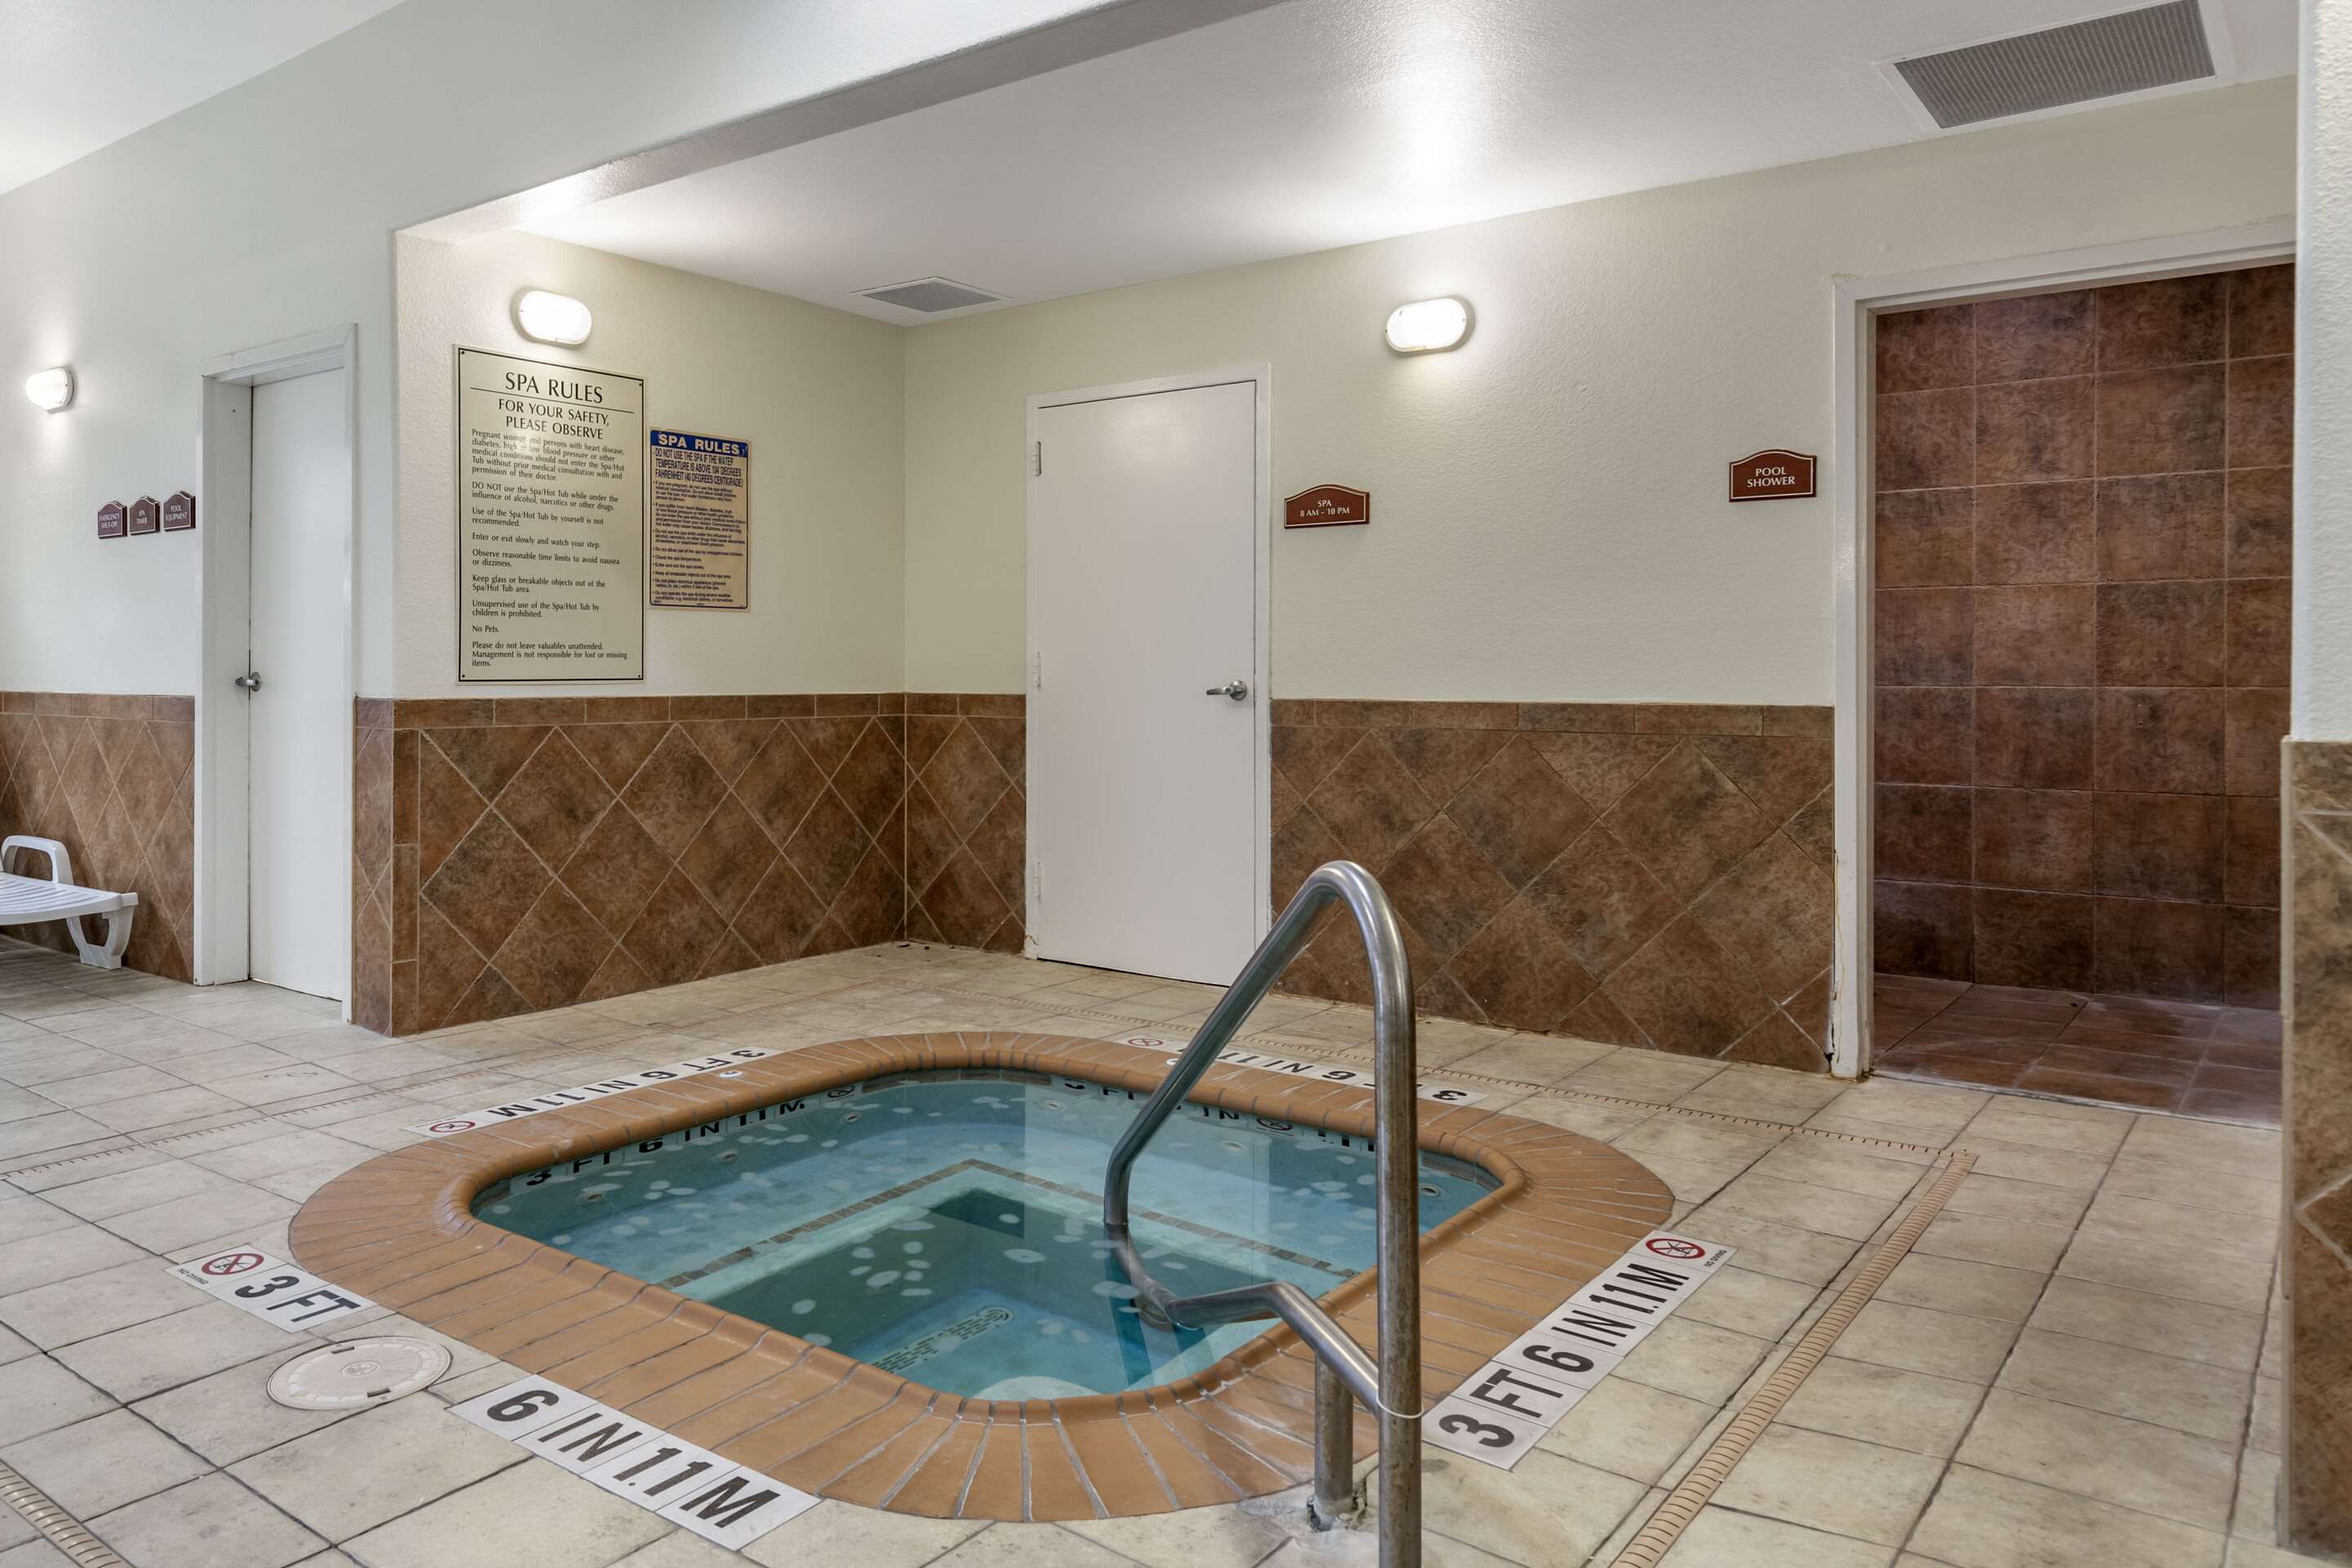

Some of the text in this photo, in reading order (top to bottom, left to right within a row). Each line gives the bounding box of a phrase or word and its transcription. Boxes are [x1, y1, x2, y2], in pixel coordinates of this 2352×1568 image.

[506, 372, 603, 403] SPA RULES
[498, 398, 608, 425] FOR YOUR SAFETY,
[506, 416, 603, 439] PLEASE OBSERVE
[472, 429, 599, 452] Pregnant persons with heart
[658, 434, 739, 454] SPA RULES
[472, 447, 497, 457] medical
[536, 454, 555, 463] should
[571, 458, 586, 467] enter
[543, 447, 560, 455] blood
[564, 451, 588, 460] pressure
[599, 453, 614, 461] other
[655, 448, 716, 464] DO NOT USE THE SPA THE
[472, 465, 506, 477] permission
[519, 470, 532, 479] their
[487, 458, 510, 467] without
[513, 461, 528, 470] prior
[532, 463, 555, 472] medical
[558, 466, 594, 476] consultation
[690, 462, 710, 473] IS ABOVE
[1755, 466, 1787, 477] POOL
[692, 473, 712, 483] DEGREES
[1747, 476, 1796, 488] SHOWER
[472, 481, 483, 489] DO
[487, 483, 501, 491] NOT
[530, 487, 555, 497] Spa/Hot
[558, 489, 568, 497] Tub
[571, 491, 586, 499] while
[589, 492, 606, 501] under
[472, 491, 501, 500] influence
[540, 497, 567, 506] narcotics
[597, 502, 613, 512] drugs.
[1317, 499, 1332, 508] SPA
[509, 510, 535, 520] Spa/Hot
[550, 514, 558, 523] by
[560, 514, 584, 524] yourself
[1307, 509, 1319, 517] AM
[1337, 506, 1350, 514] PM
[472, 516, 519, 526] recommended.
[472, 532, 488, 541] Enter
[515, 536, 533, 546] slowly
[587, 541, 600, 550] step.
[472, 549, 499, 557] Observe
[502, 550, 535, 559] reasonable
[472, 574, 488, 584] Keep
[491, 575, 506, 585] glass
[519, 577, 548, 585] breakable
[551, 578, 572, 587] objects
[472, 583, 498, 593] Spa/Hot
[472, 599, 514, 609] Unsupervised
[552, 602, 577, 611] Spa/Hot
[592, 604, 599, 612] by
[509, 610, 541, 618] prohibited.
[472, 651, 514, 659] Management
[537, 651, 572, 659] responsible
[606, 651, 626, 659] missing
[683, 1058, 733, 1071] FT
[640, 1071, 678, 1080] 6
[584, 1080, 638, 1094] IN
[1432, 1089, 1468, 1101] 3
[234, 1276, 361, 1322] 3 FT
[1550, 1310, 1637, 1347] IN
[1522, 1345, 1594, 1373] 6
[1470, 1368, 1563, 1418] FT
[487, 1389, 560, 1422] 6
[537, 1413, 643, 1462] IN
[1439, 1414, 1515, 1448] 3
